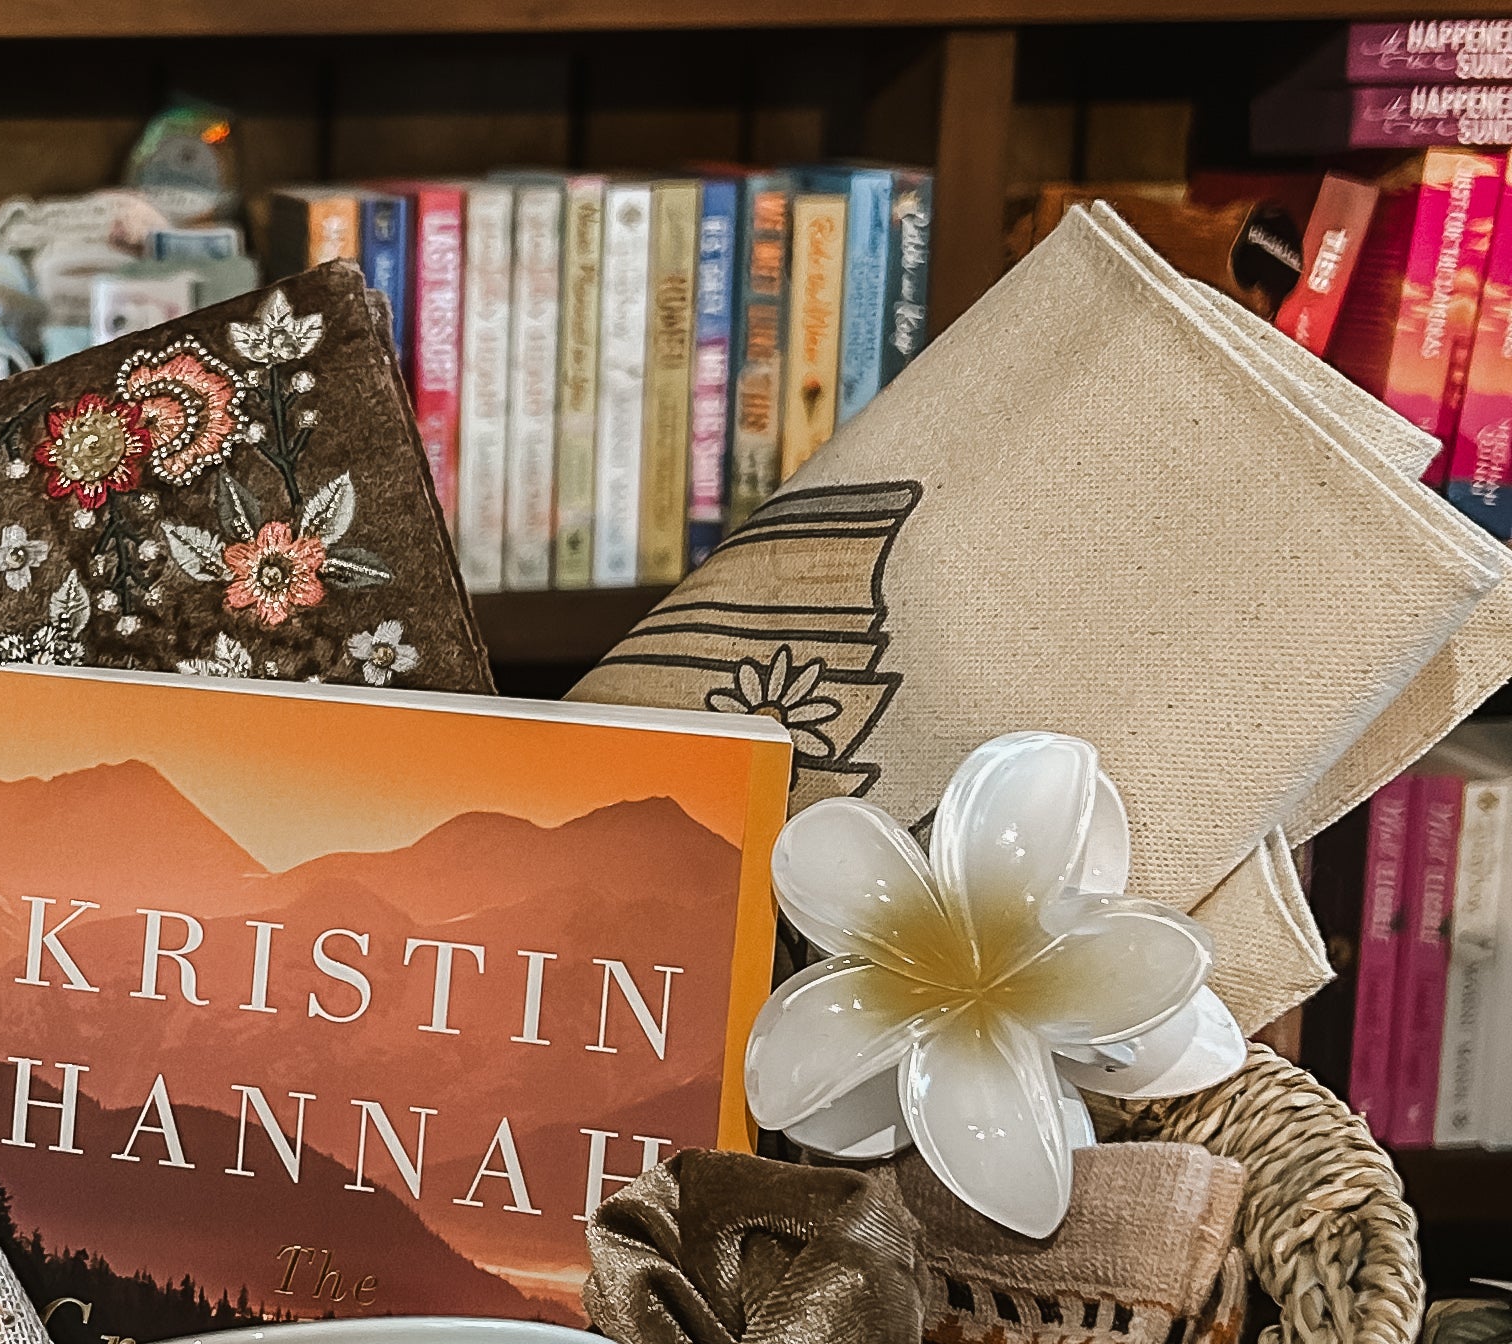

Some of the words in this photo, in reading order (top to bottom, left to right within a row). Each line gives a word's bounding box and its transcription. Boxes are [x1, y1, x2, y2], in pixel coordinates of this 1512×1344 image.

[13, 894, 685, 1063] KRISTIN
[0, 1055, 674, 1225] HANNAH
[274, 1244, 380, 1306] The
